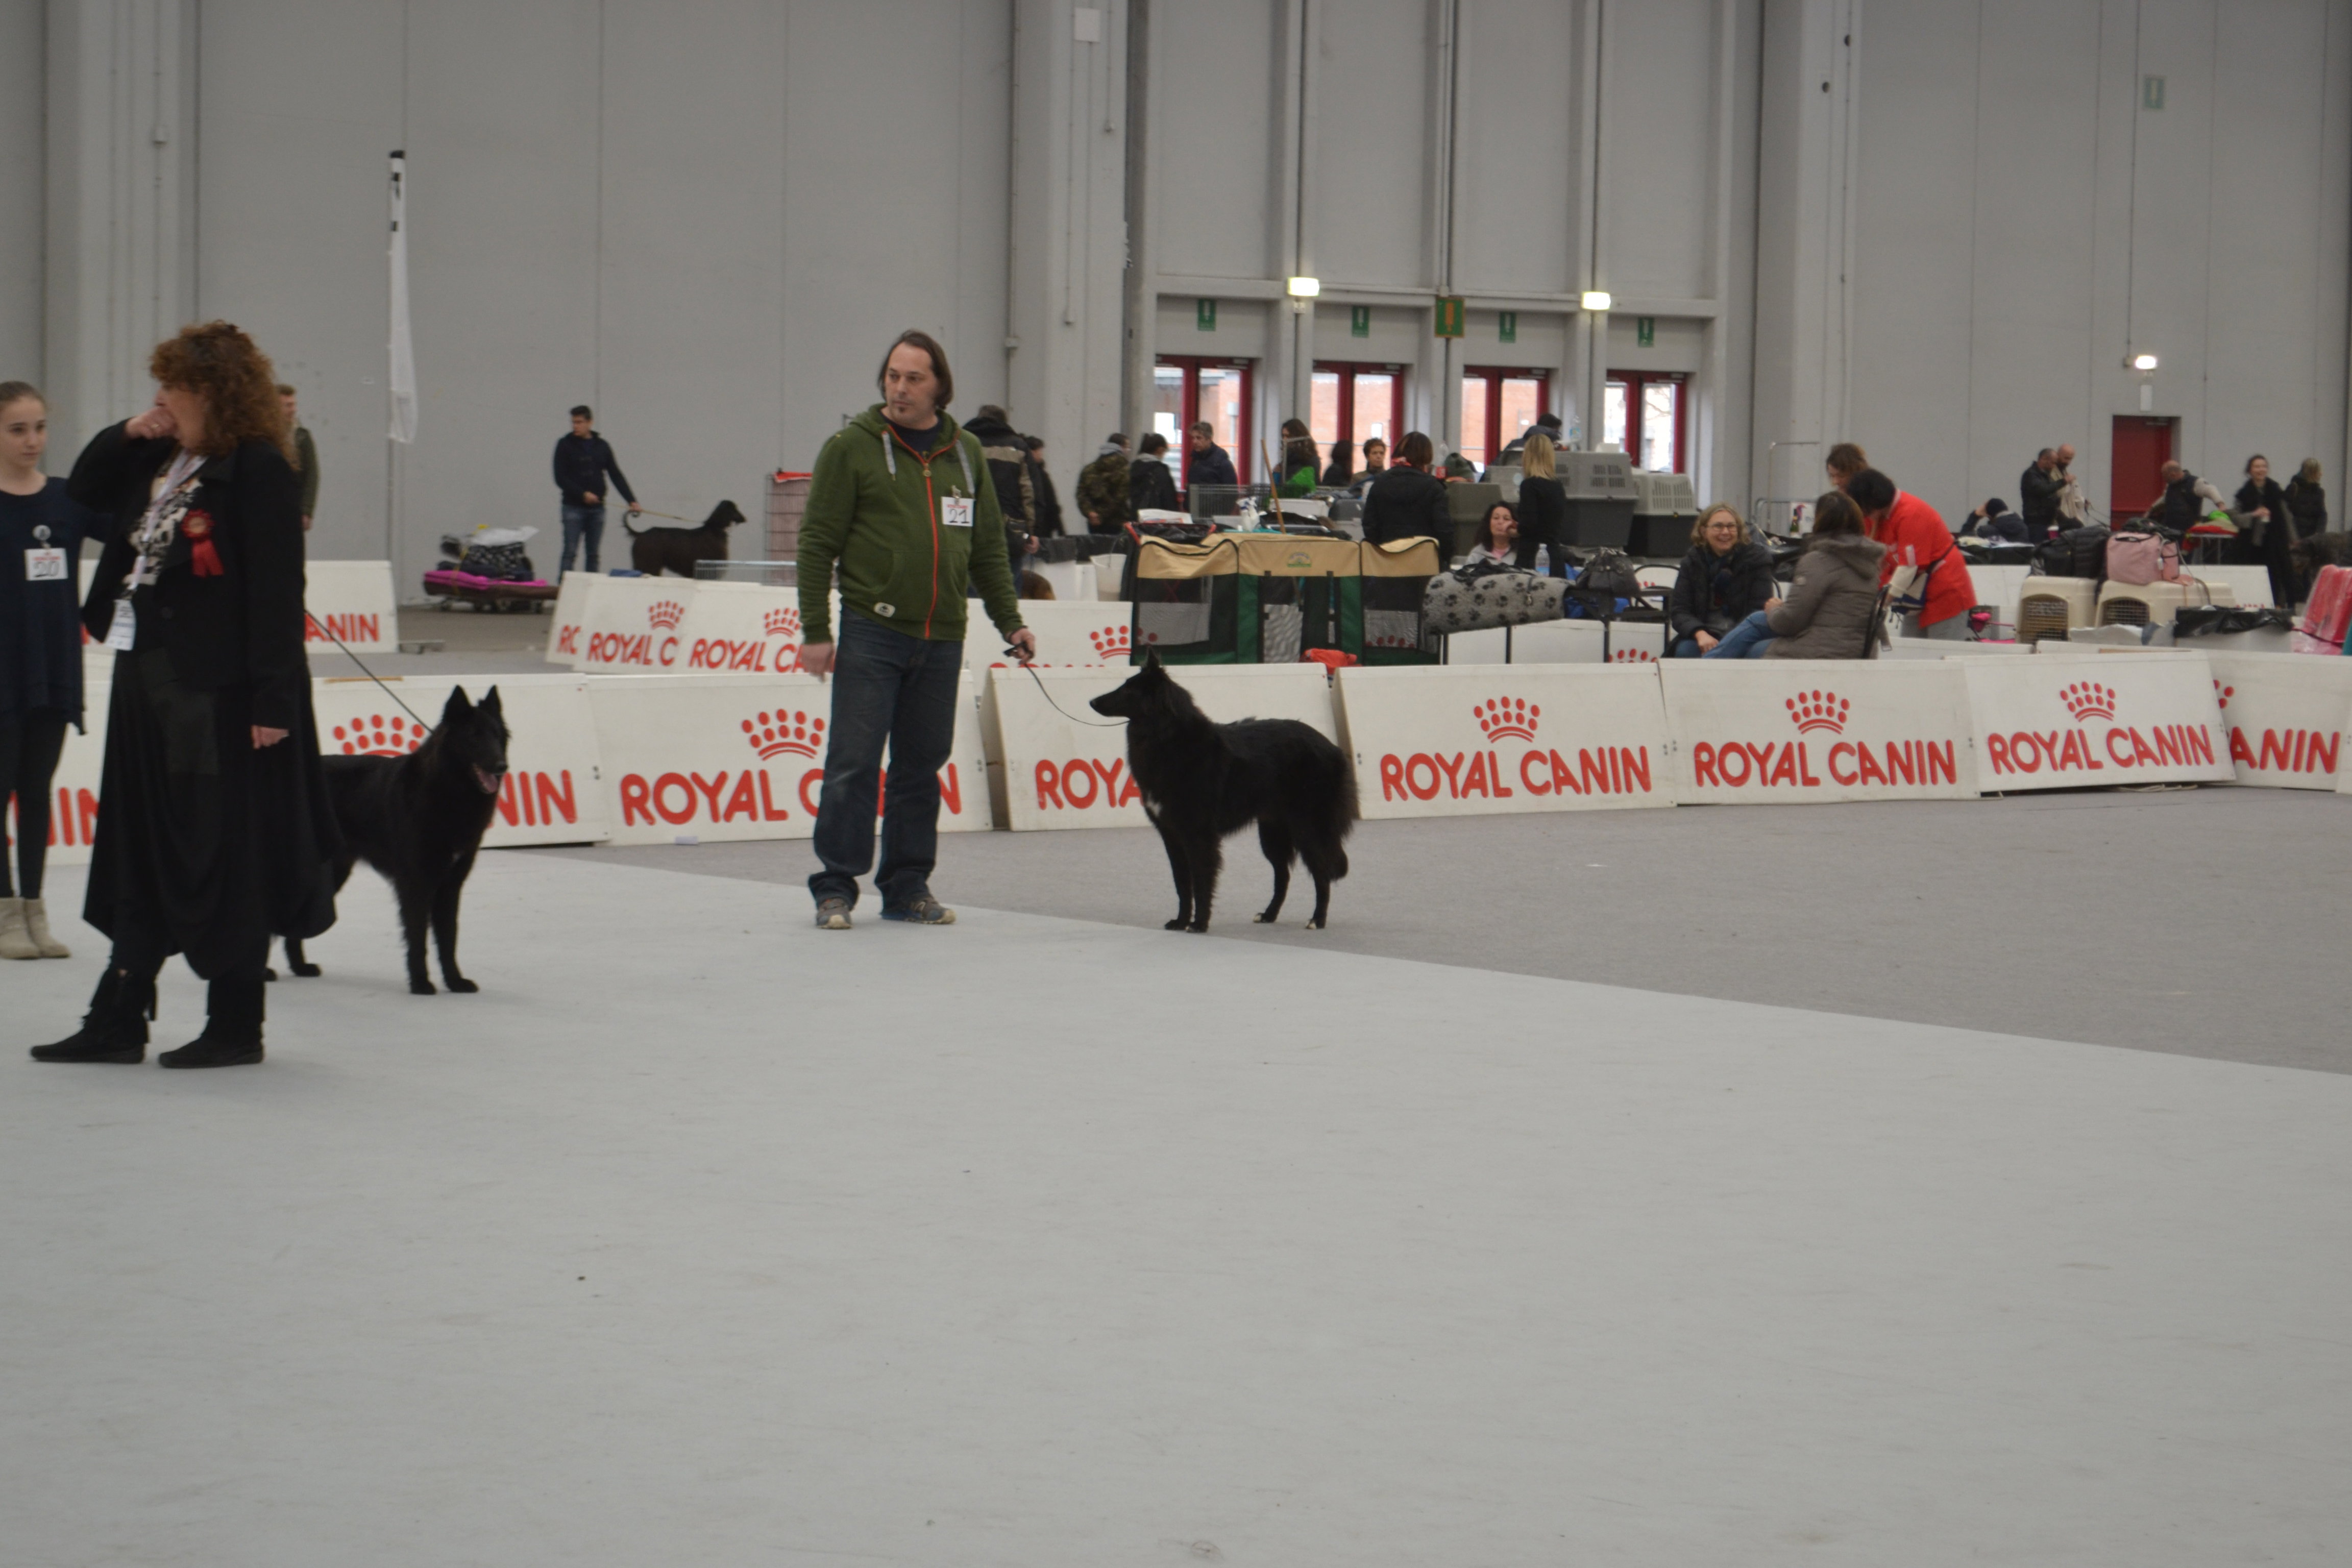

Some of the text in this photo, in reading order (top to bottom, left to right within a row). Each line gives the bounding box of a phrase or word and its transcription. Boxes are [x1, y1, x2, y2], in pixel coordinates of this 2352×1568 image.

[949, 508, 970, 524] 21
[33, 561, 60, 578] 20
[587, 632, 654, 665] ROYAL
[688, 638, 767, 673] ROYAL
[1380, 745, 1652, 802] ROYAL CANIN
[1693, 739, 1958, 788] ROYAL CANIN
[1987, 724, 2216, 775] ROYAL CANIN
[2226, 726, 2341, 774] ANIN
[620, 769, 790, 827] ROYAL
